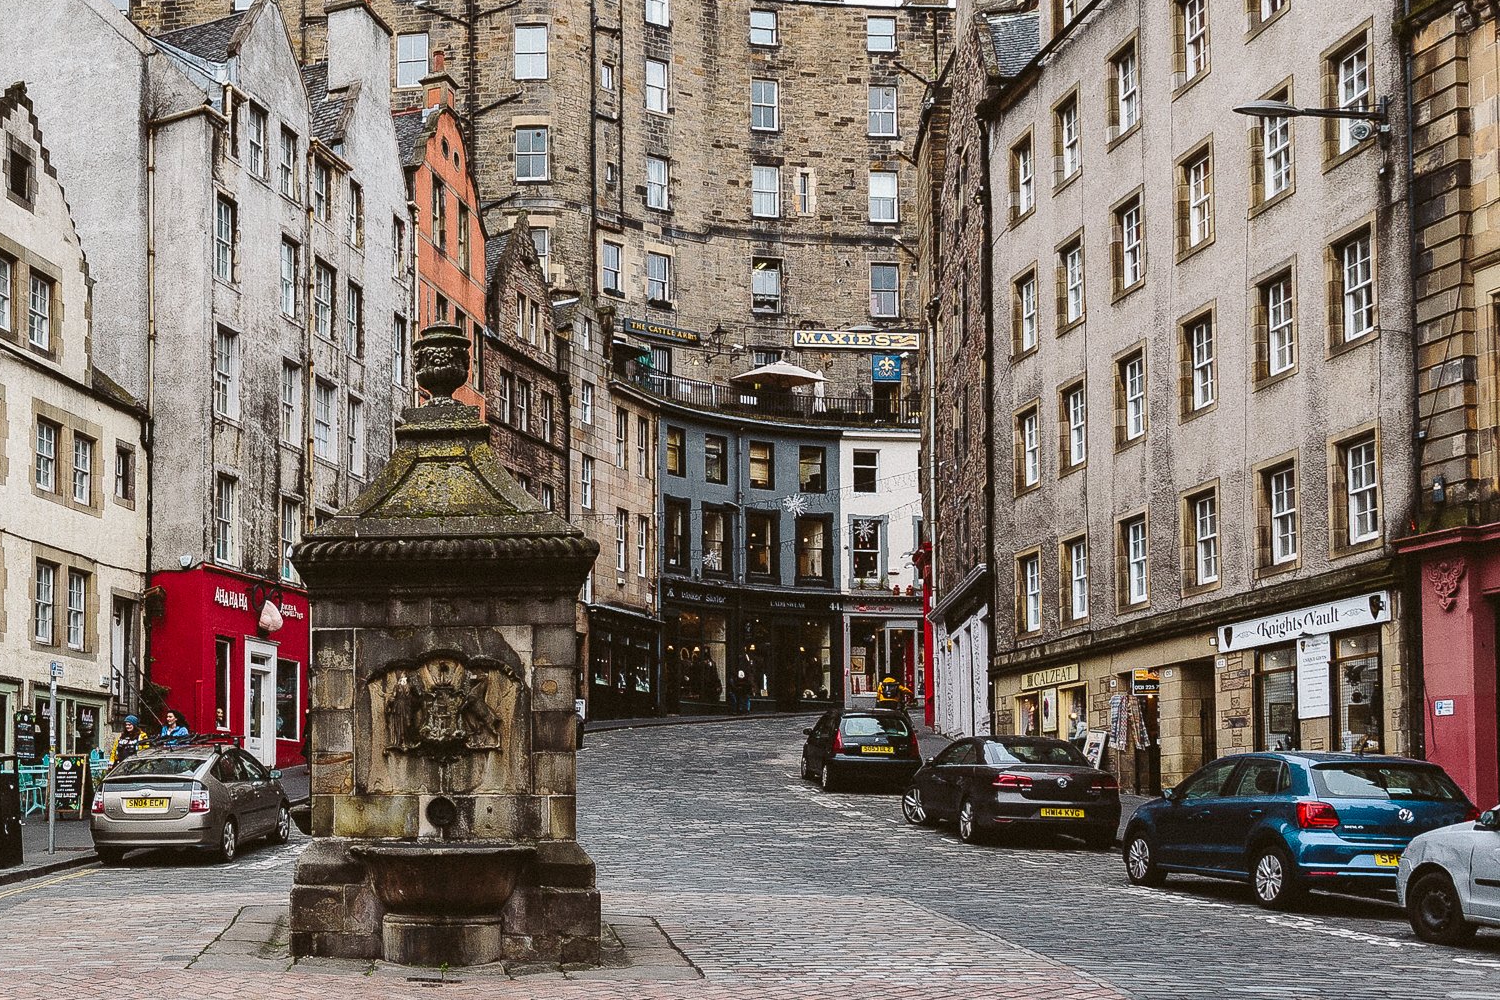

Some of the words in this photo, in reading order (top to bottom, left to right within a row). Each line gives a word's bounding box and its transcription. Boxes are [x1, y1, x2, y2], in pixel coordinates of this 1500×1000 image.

[630, 321, 645, 330] THE
[648, 324, 676, 336] CASTLE
[798, 332, 892, 346] MAXIES
[1256, 618, 1302, 638] Knights
[1304, 606, 1339, 626] Vault
[1034, 666, 1072, 686] CALZEAT
